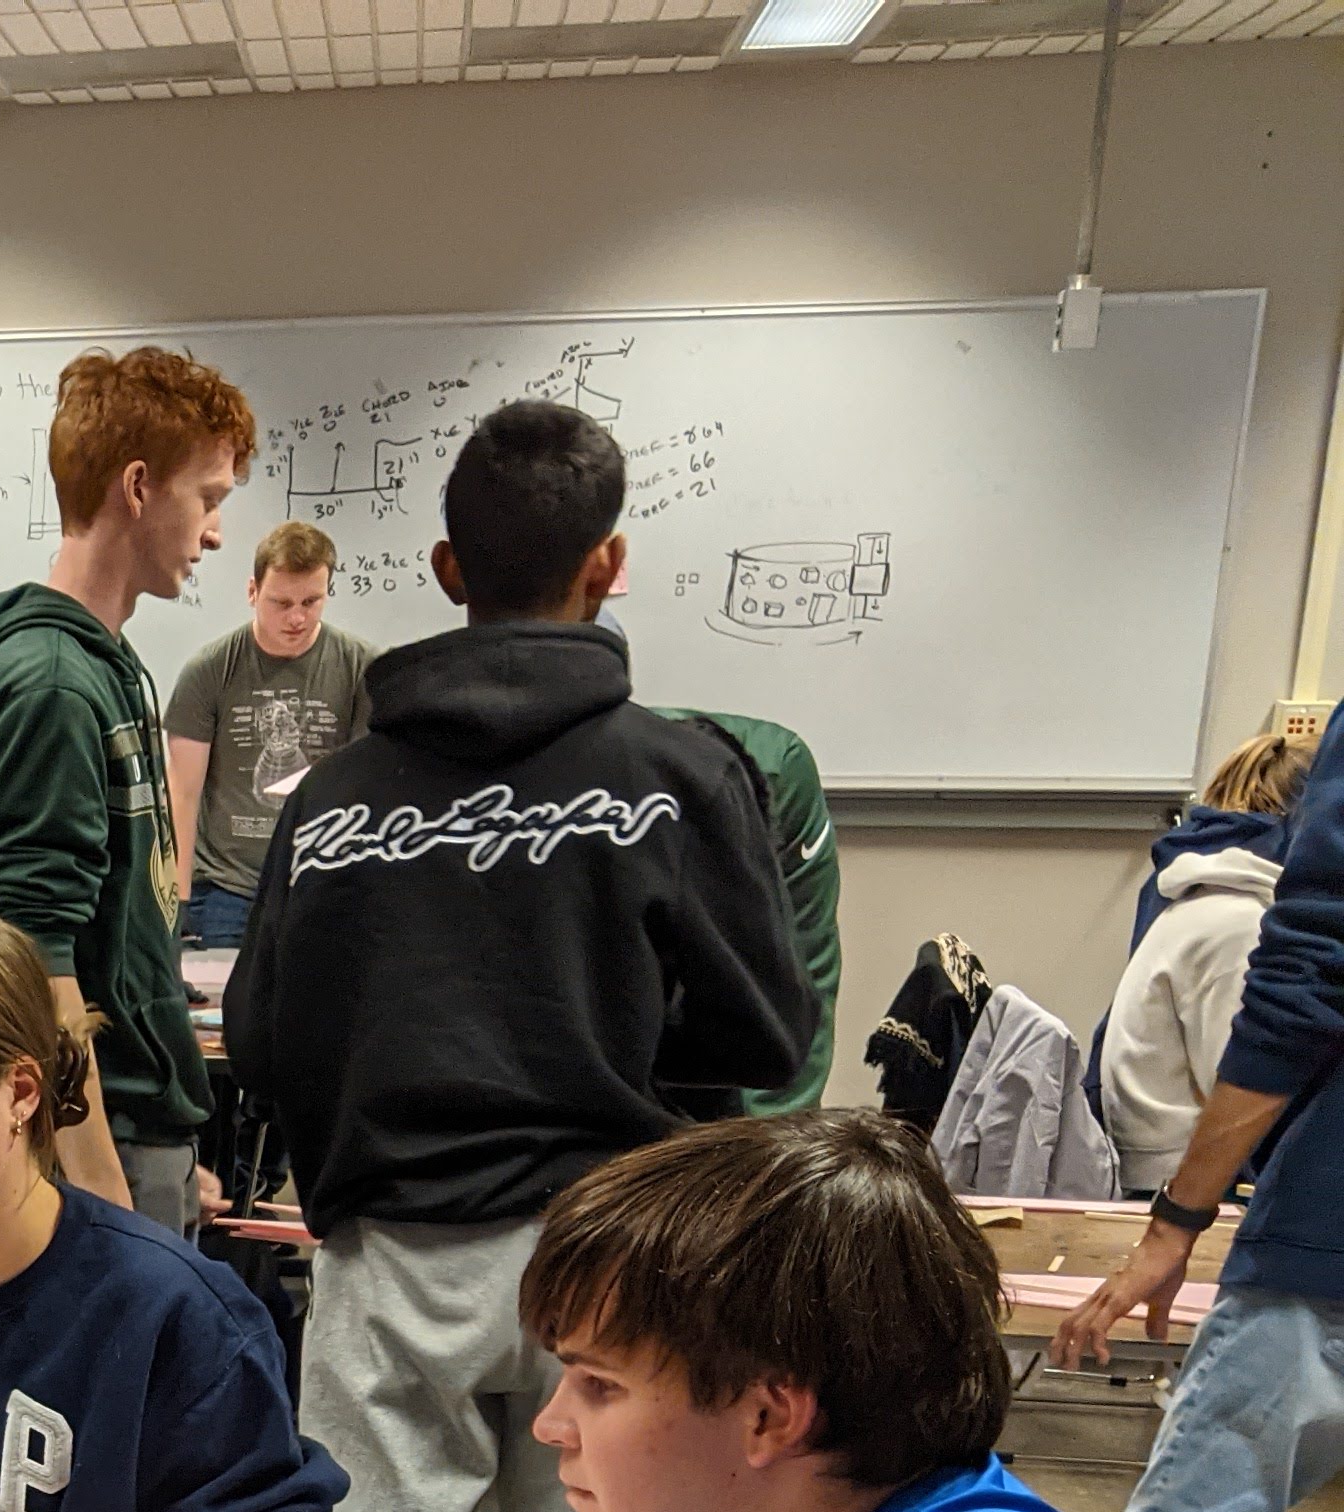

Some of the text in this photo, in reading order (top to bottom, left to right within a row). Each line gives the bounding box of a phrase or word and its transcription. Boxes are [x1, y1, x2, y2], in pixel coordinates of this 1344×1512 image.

[17, 372, 52, 400] the
[689, 450, 715, 473] 66
[689, 477, 716, 498] 21
[350, 574, 373, 598] 33
